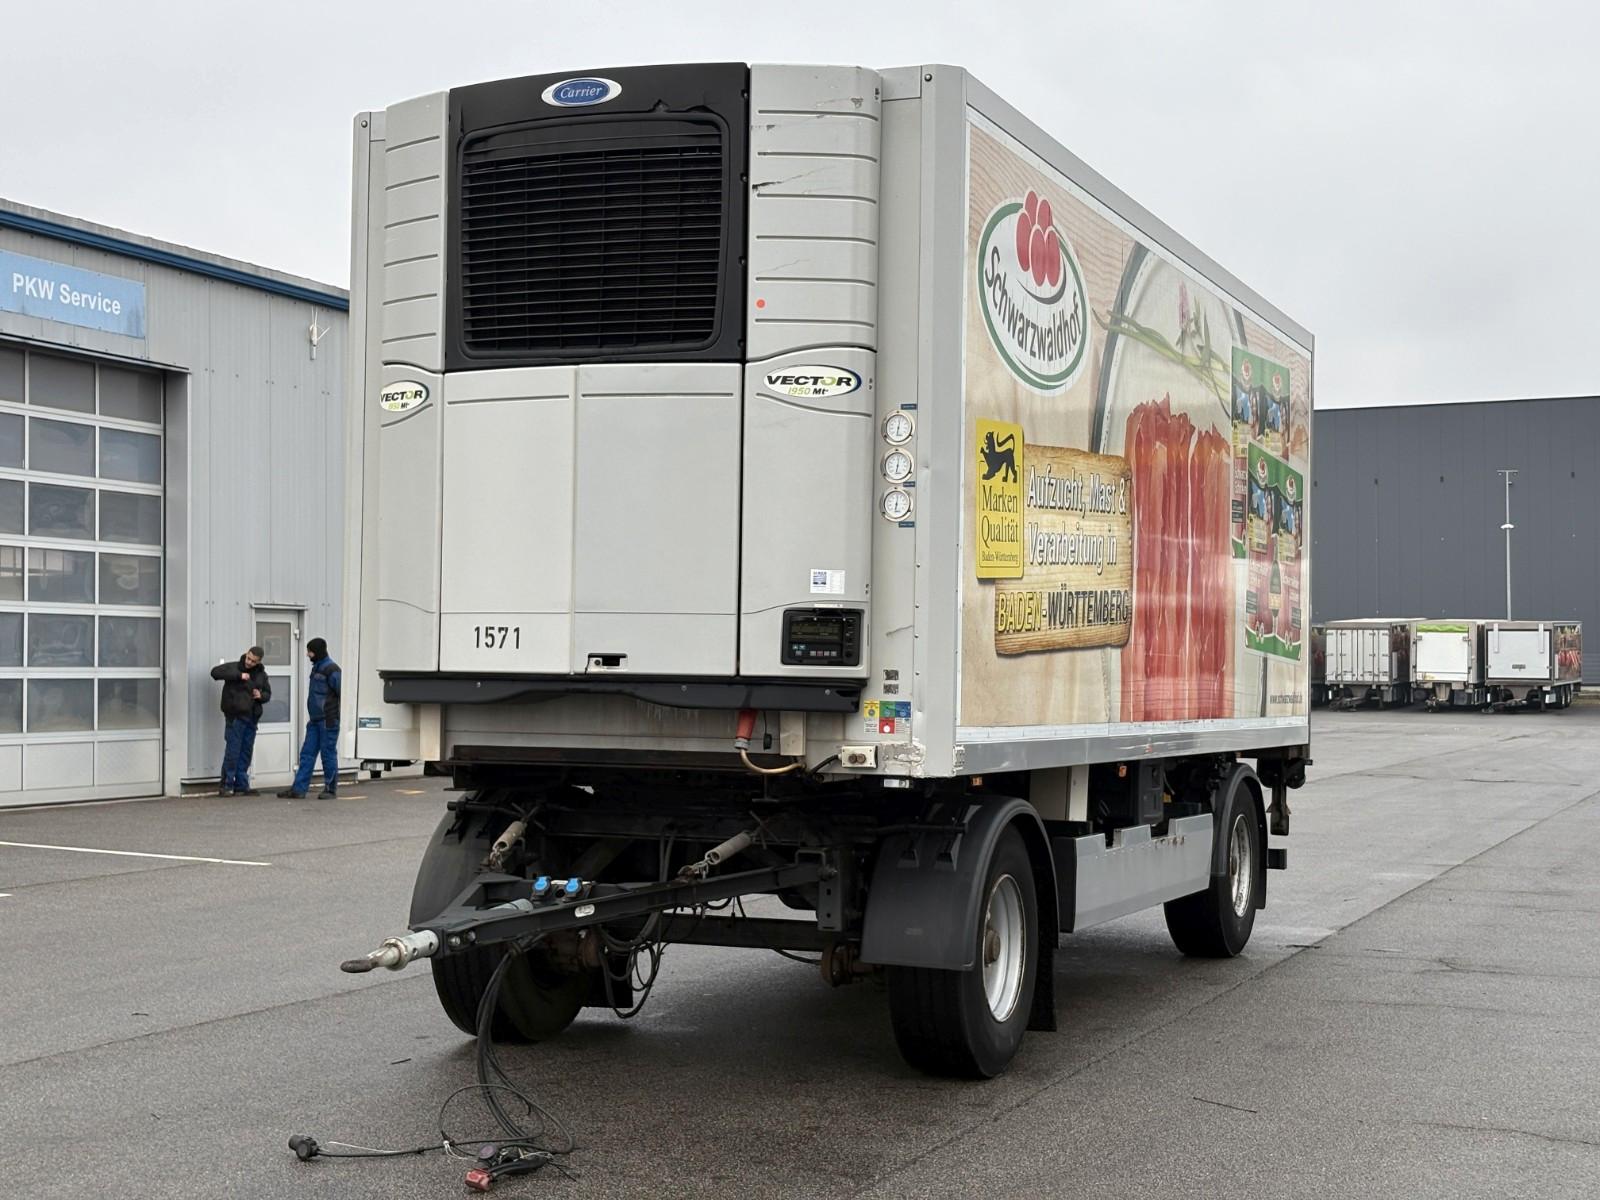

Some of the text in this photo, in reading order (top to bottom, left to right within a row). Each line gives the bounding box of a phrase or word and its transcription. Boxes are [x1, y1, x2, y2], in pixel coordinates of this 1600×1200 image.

[560, 86, 602, 98] Carrier
[13, 272, 121, 315] PKW Service
[985, 246, 1081, 361] Schwarzwaldhof
[380, 390, 423, 402] VECTOR
[767, 375, 852, 387] VECTOR
[788, 387, 811, 395] 1950
[982, 484, 1018, 514] Marken
[1026, 463, 1127, 519] Aufzucht, Mast &
[981, 514, 1019, 549] Qualität
[1028, 520, 1118, 575] Verarbeitung in
[997, 583, 1130, 633] BADEN-WÜRTTEMBERG
[474, 626, 520, 650] 1571
